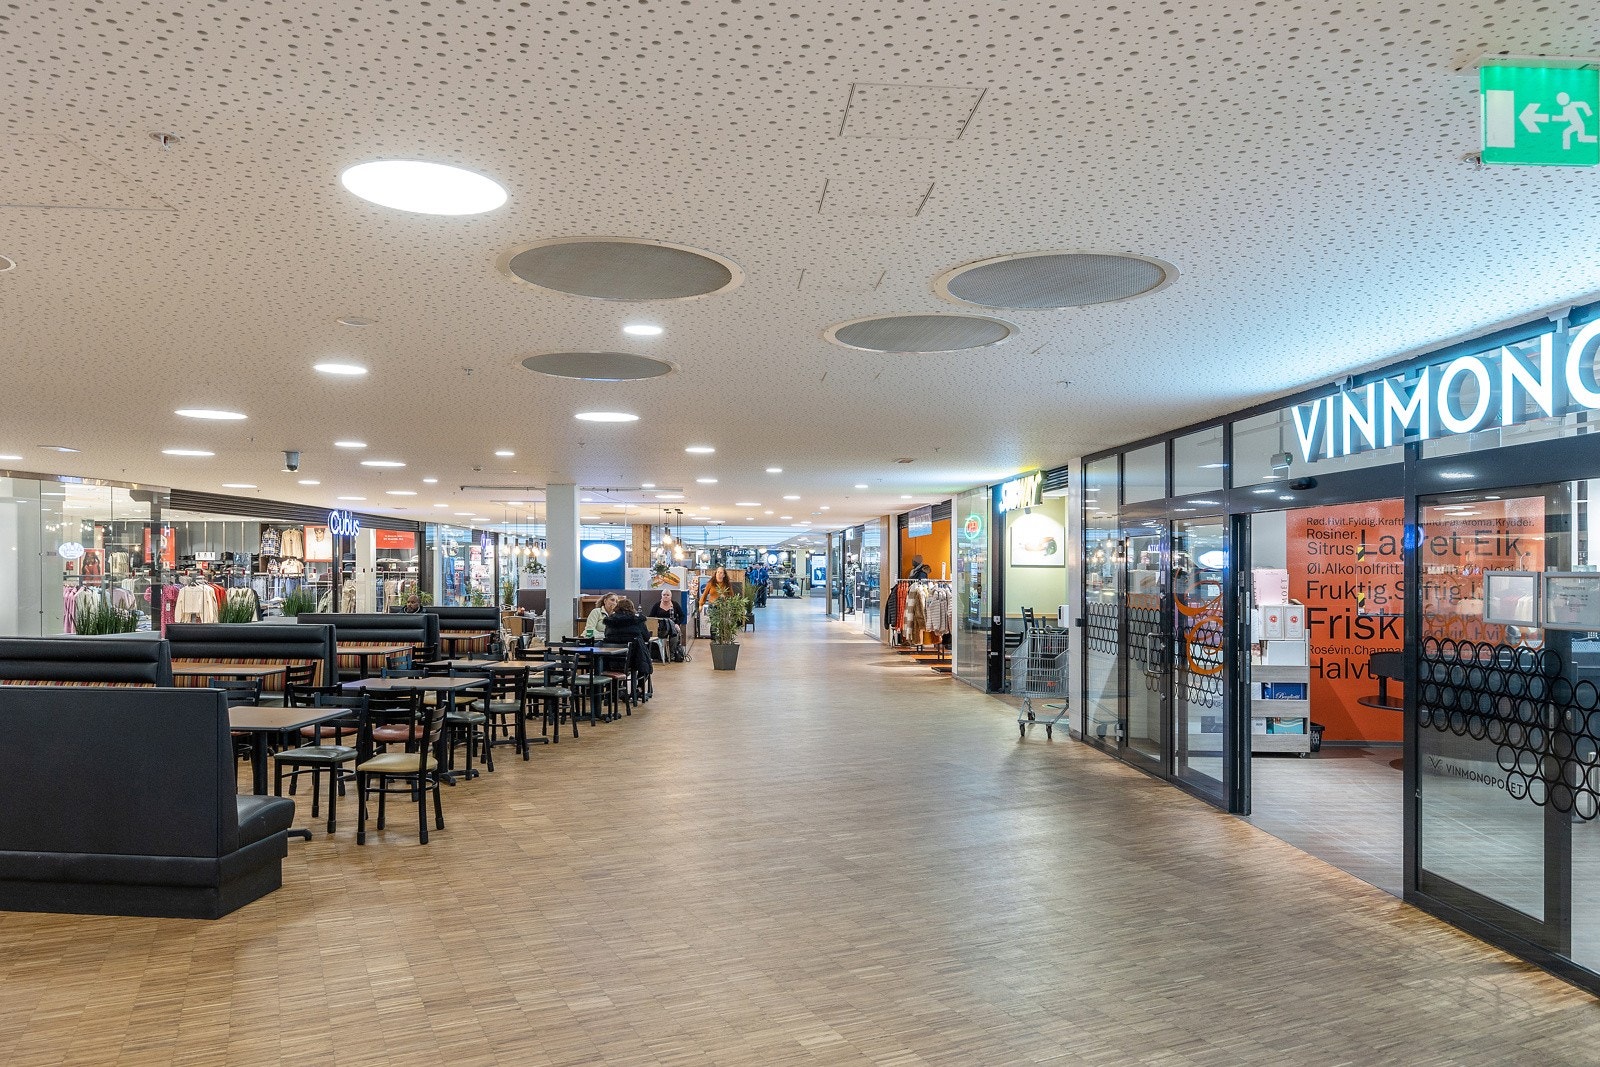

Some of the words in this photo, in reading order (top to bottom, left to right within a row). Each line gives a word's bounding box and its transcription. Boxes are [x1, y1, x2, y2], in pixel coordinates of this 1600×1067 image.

[329, 510, 360, 537] Cubus
[1306, 528, 1358, 540] Rosiner.
[1446, 763, 1523, 796] VINMONOPOLET
